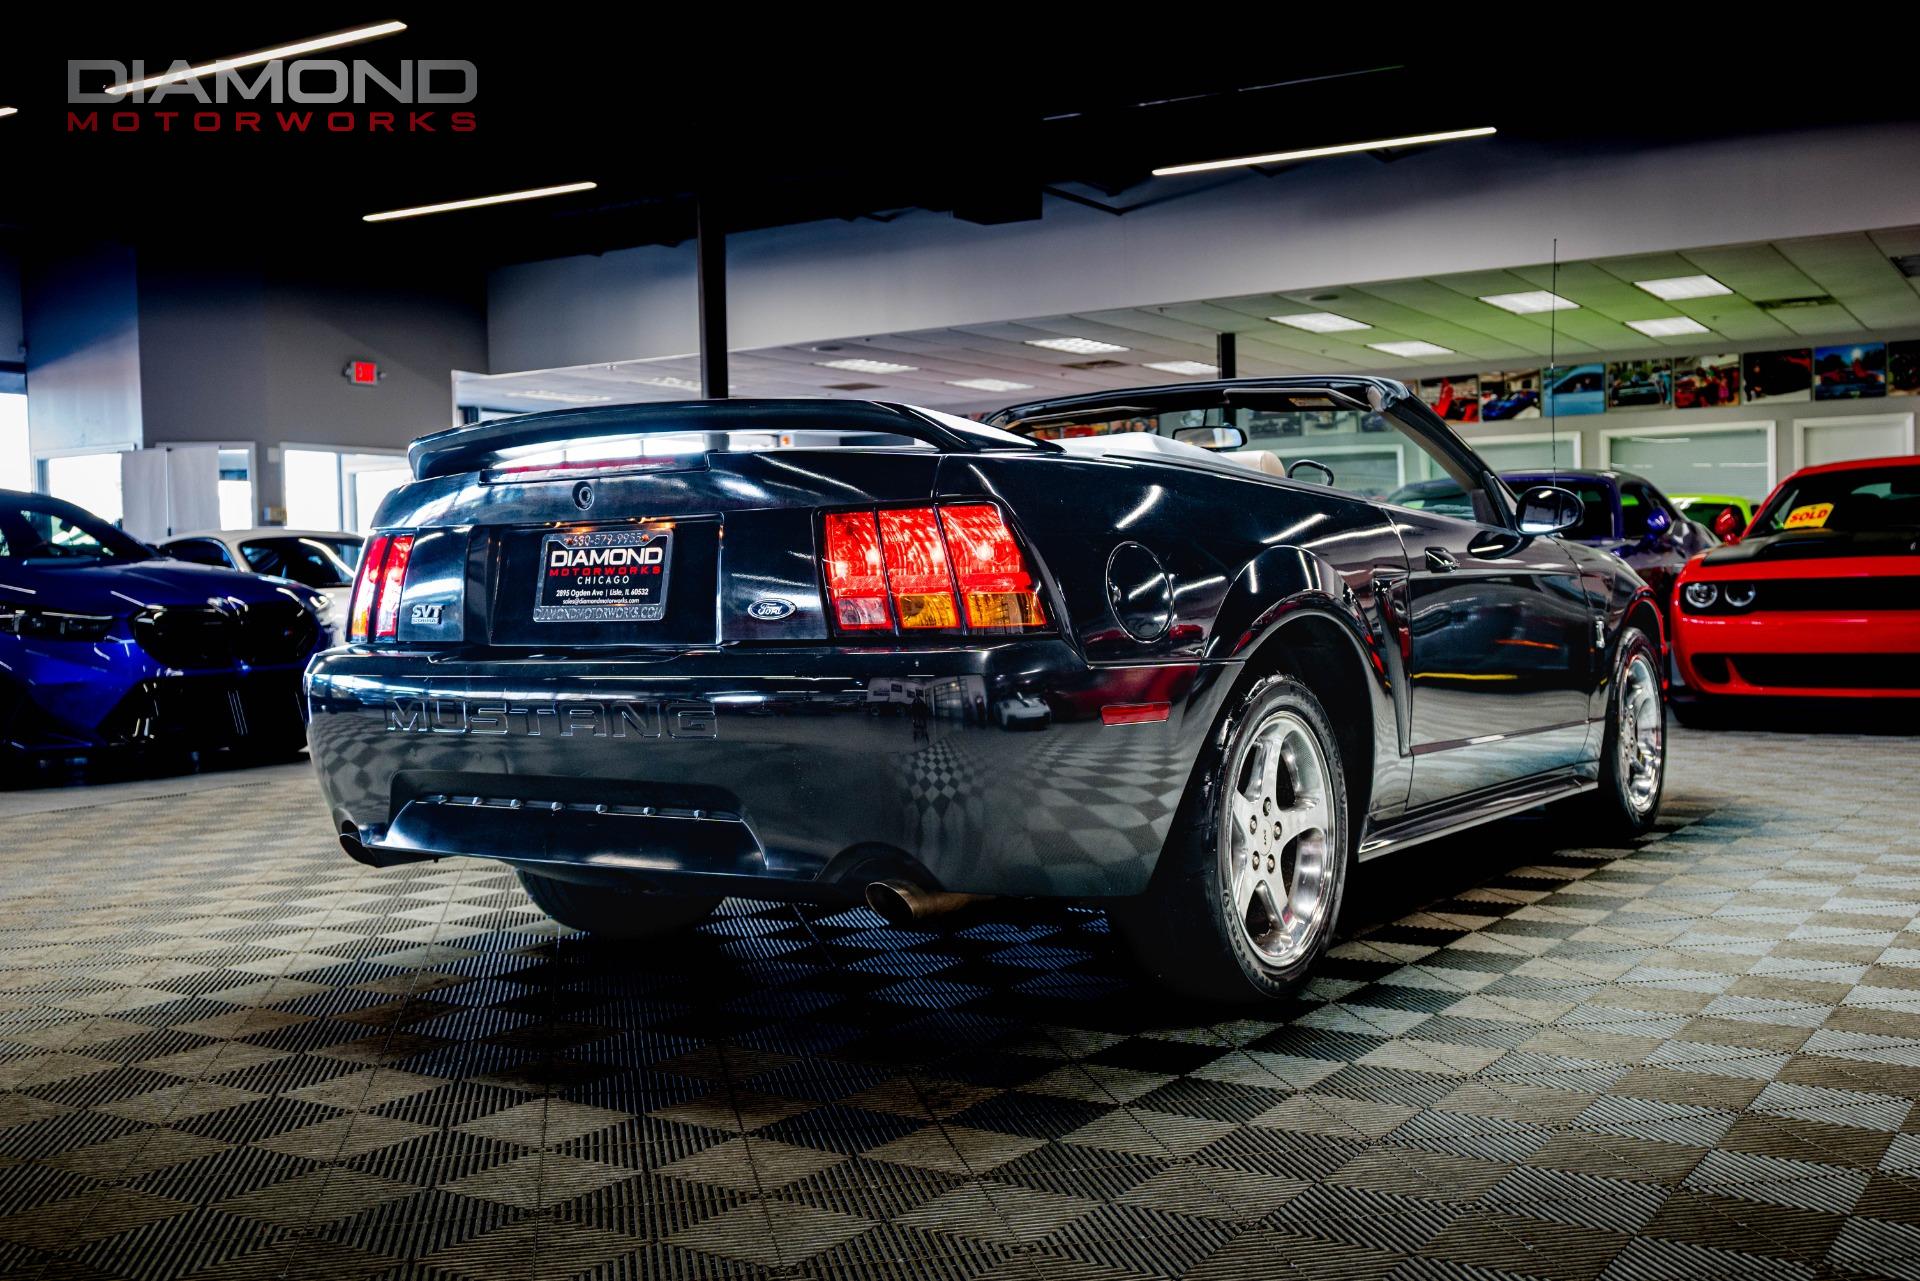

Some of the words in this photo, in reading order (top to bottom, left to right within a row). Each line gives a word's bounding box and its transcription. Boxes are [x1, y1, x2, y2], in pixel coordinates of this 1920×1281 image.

[1790, 509, 1828, 522] SOLD
[551, 547, 663, 567] DIAMOND
[549, 565, 661, 577] MOTORWORKS
[577, 575, 630, 585] CHICAGO
[570, 589, 591, 598] Ogden
[591, 588, 604, 596] Ave
[630, 587, 649, 596] 60532
[411, 604, 442, 618] SVT
[757, 603, 783, 615] Ford
[384, 697, 718, 739] MUSTANG
